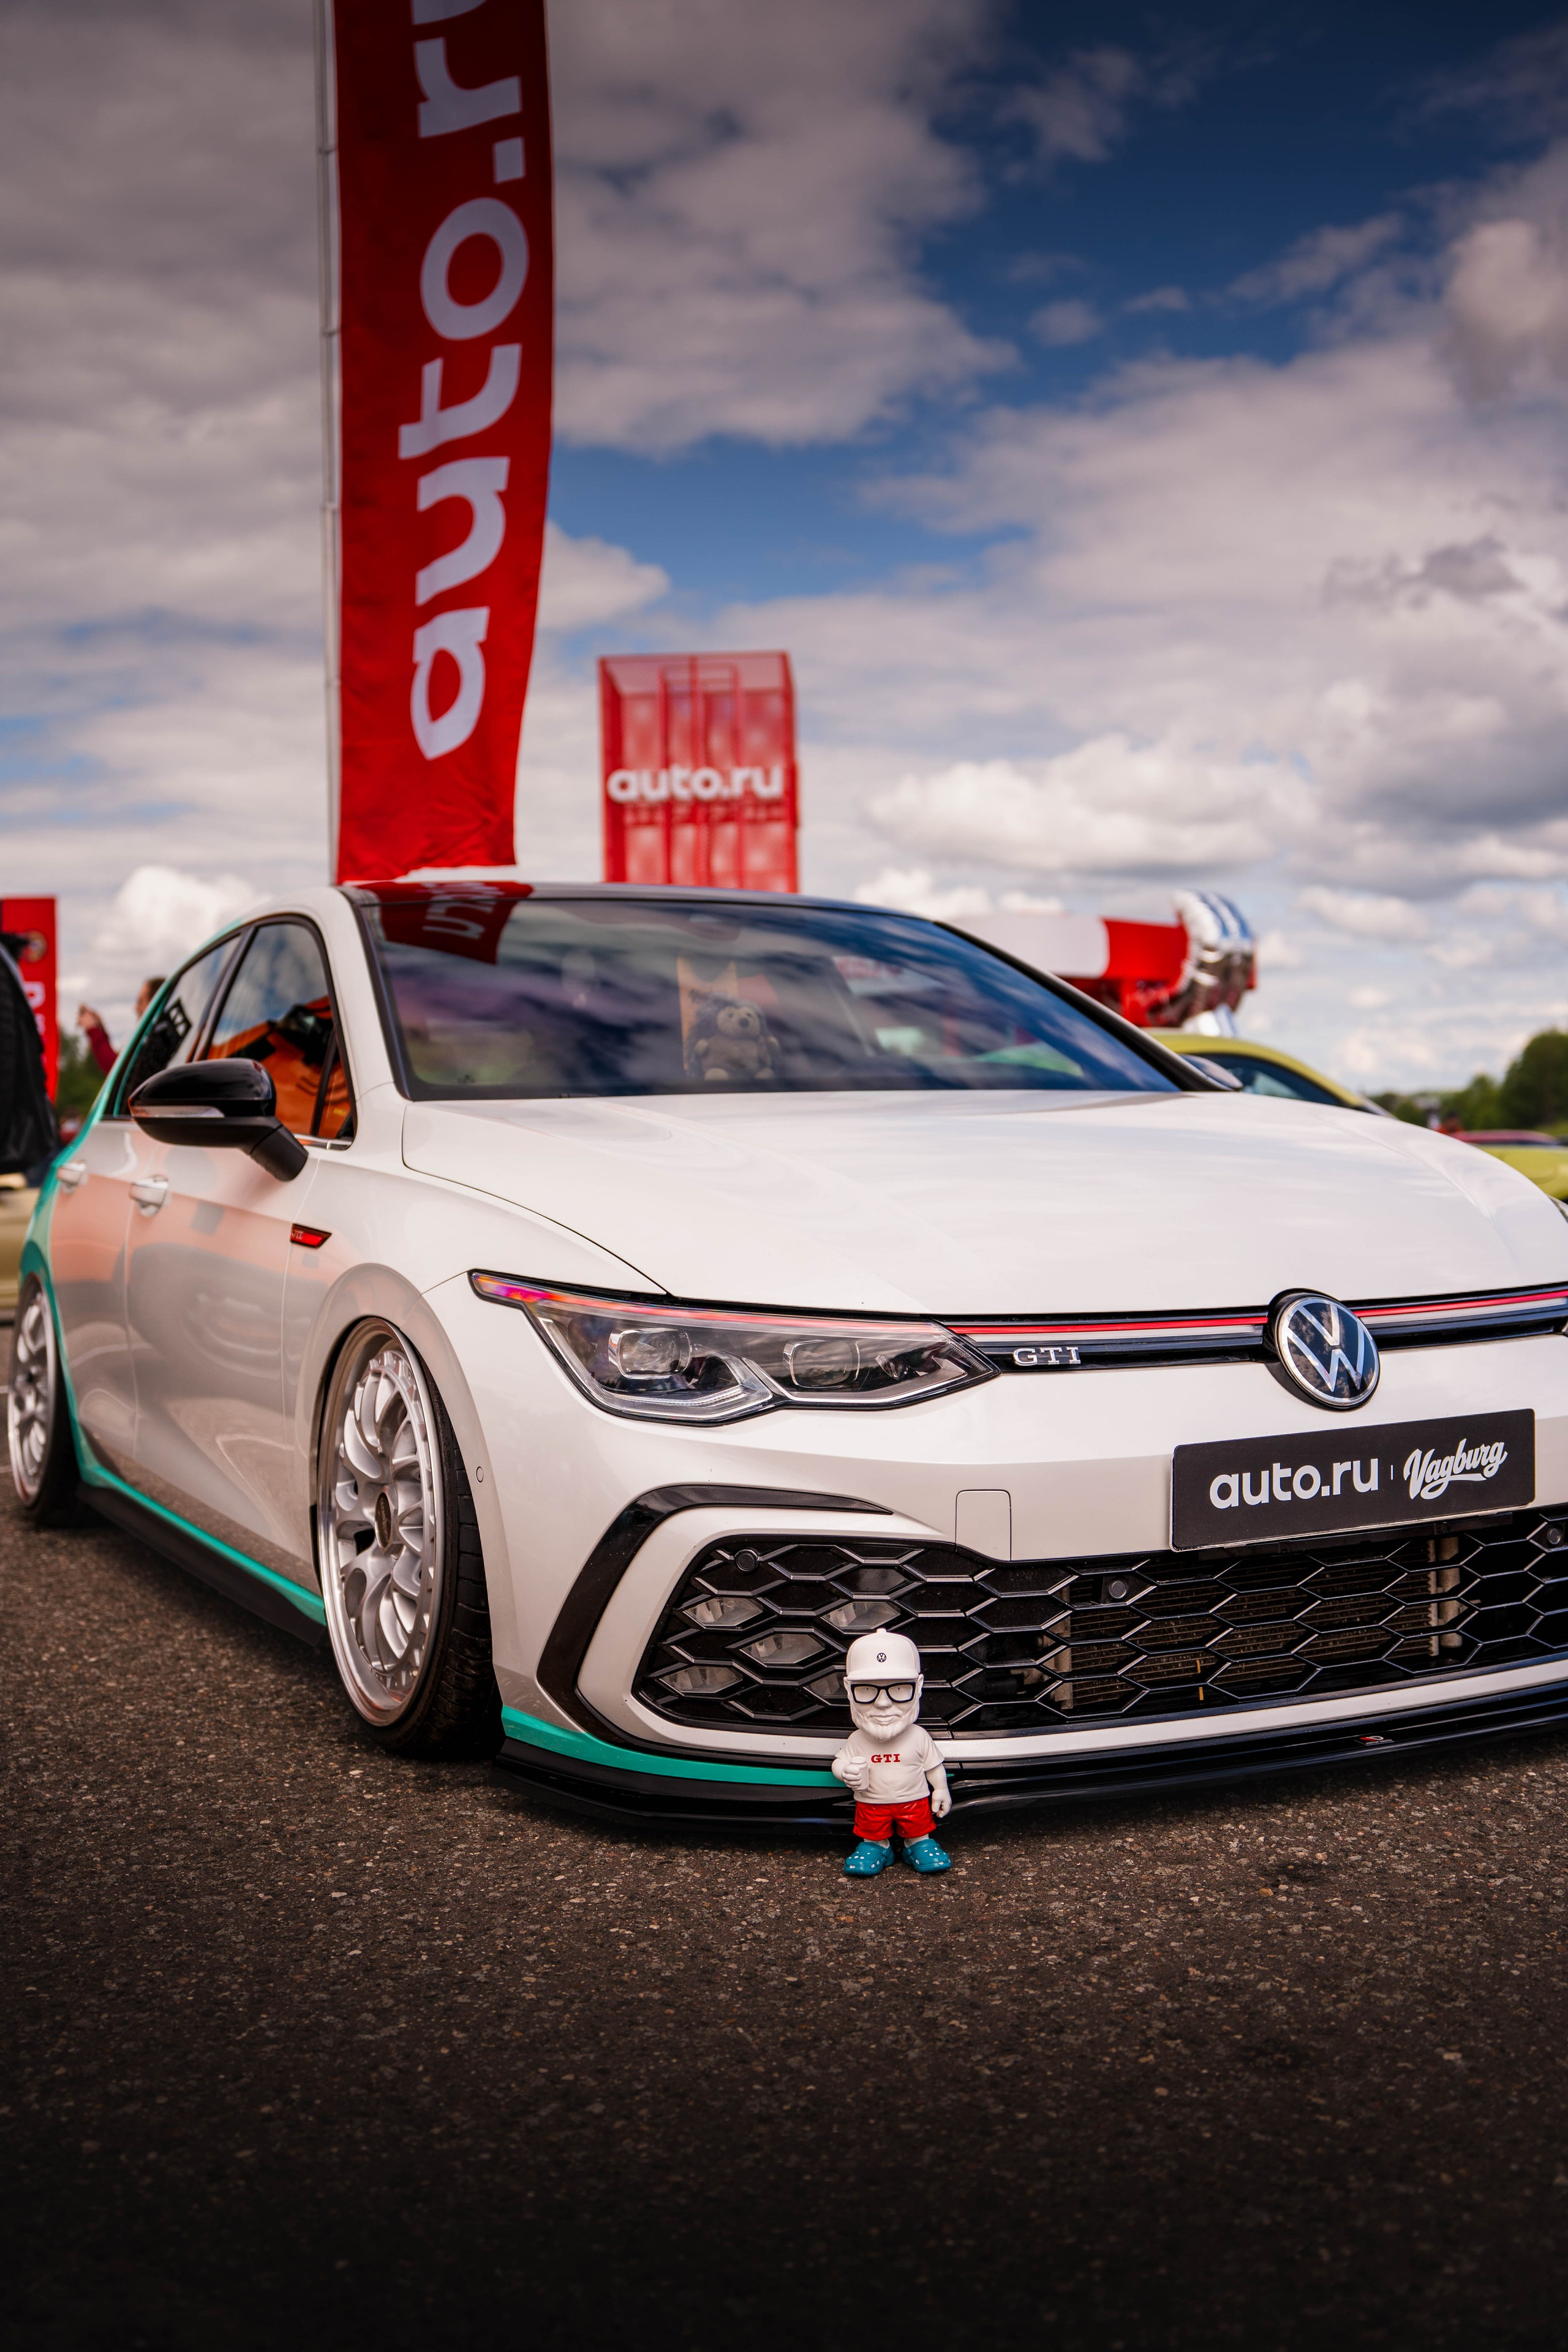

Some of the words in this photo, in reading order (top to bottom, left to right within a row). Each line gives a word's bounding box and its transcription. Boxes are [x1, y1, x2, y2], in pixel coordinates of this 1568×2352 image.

[398, 0, 529, 760] auto.r
[608, 763, 784, 803] auto.ru
[1012, 1346, 1082, 1366] GTI
[1209, 1458, 1379, 1509] auto.ru
[1403, 1438, 1508, 1500] Vagburg
[870, 1753, 901, 1764] GTI
